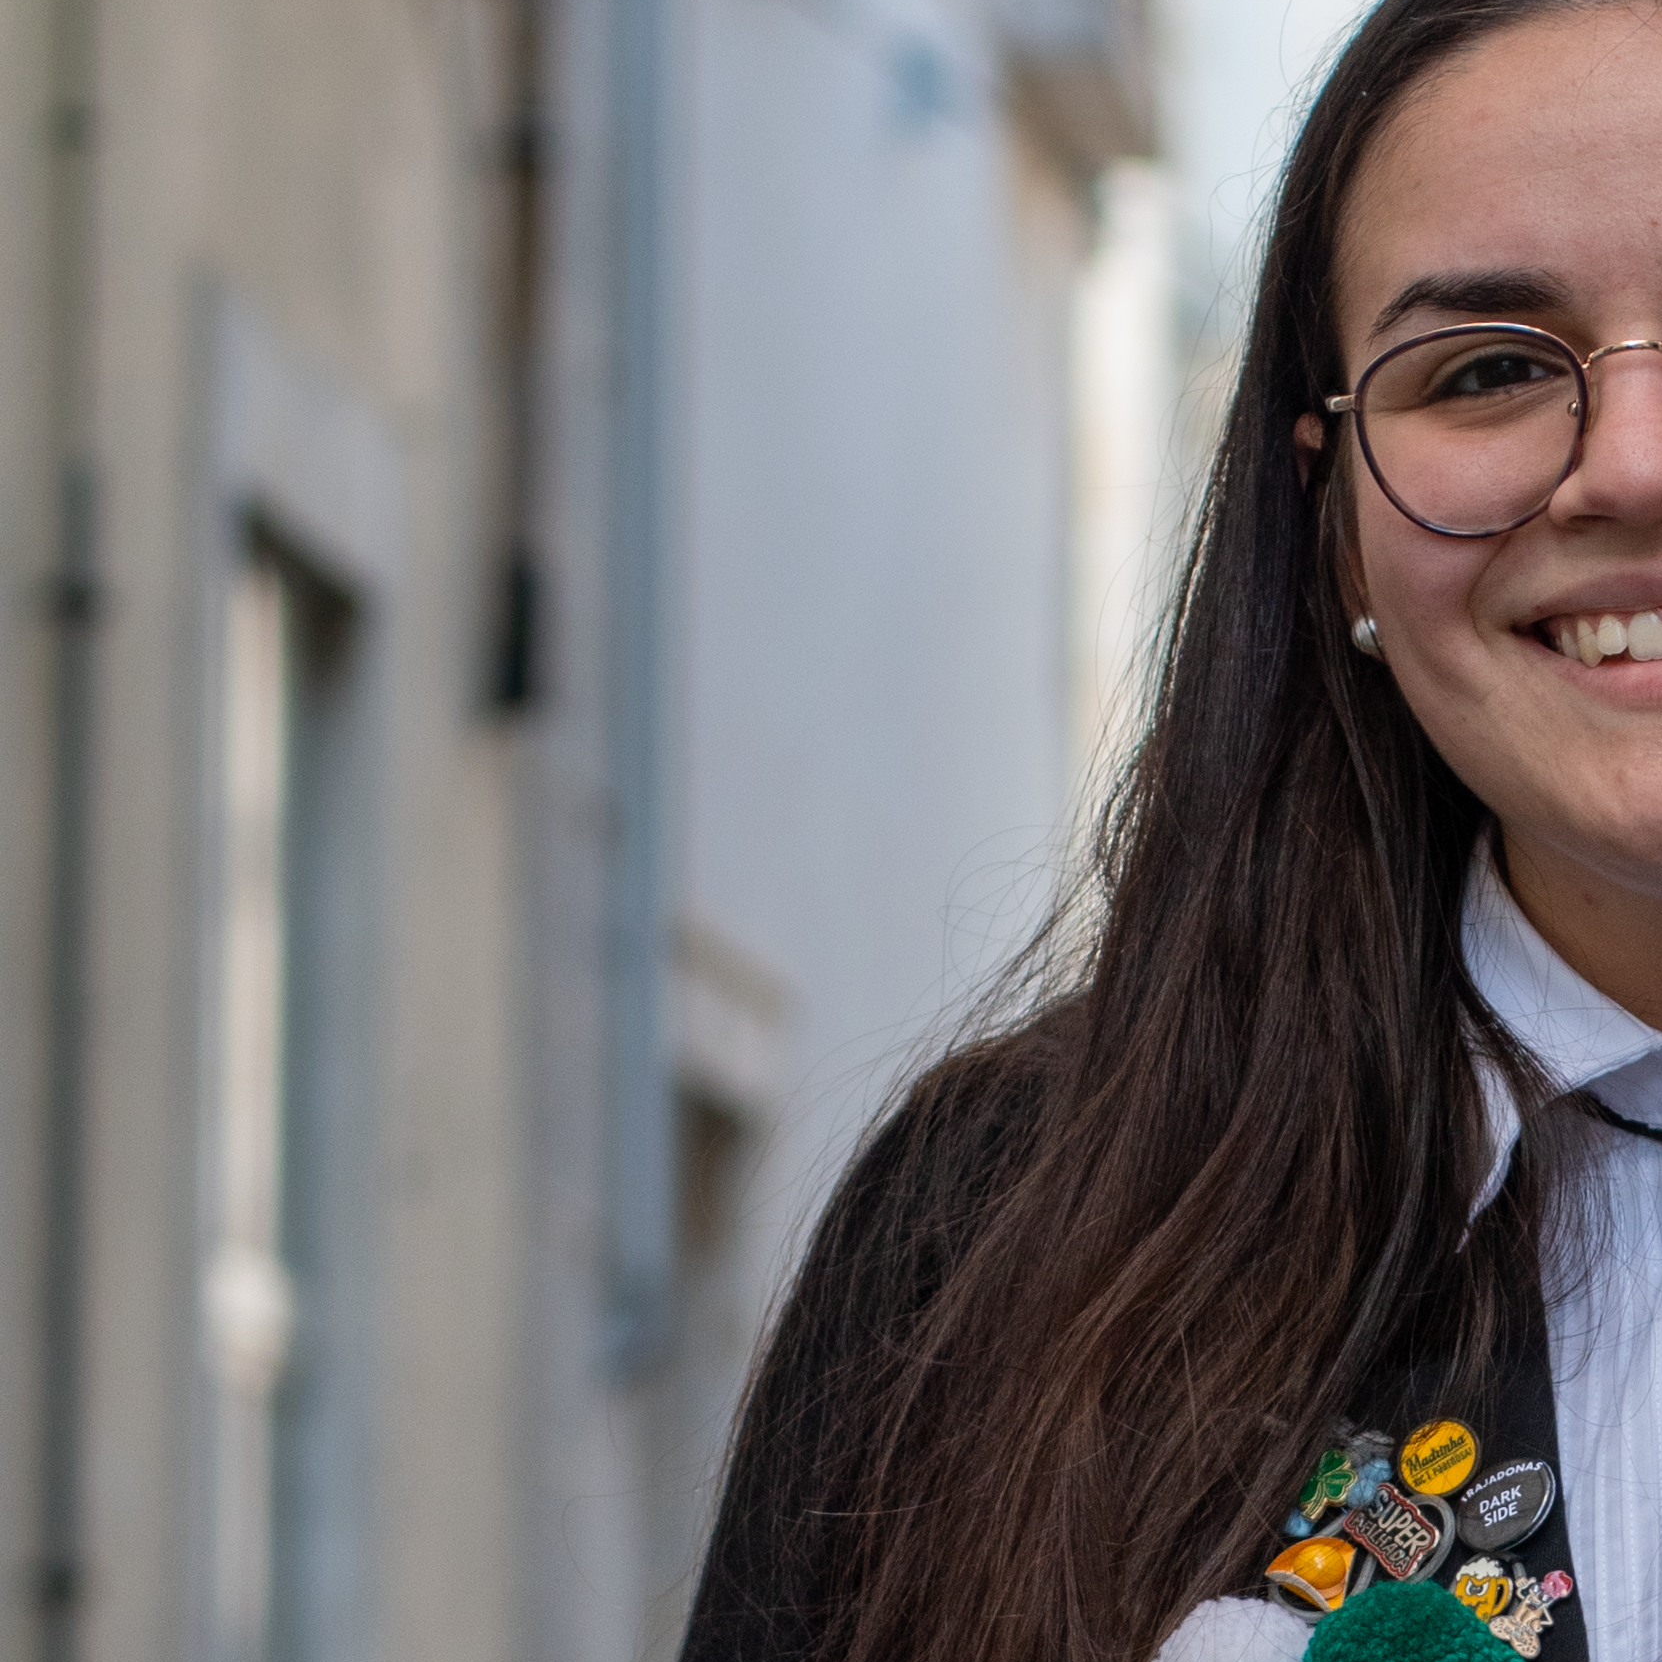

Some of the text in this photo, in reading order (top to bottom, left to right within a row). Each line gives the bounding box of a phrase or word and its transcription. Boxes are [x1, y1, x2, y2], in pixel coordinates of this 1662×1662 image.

[1406, 1435, 1465, 1474] Madrinha
[1461, 1461, 1543, 1502] TRAJADONAS
[1479, 1484, 1522, 1514] DARK
[1368, 1489, 1432, 1557] SUPER
[1484, 1501, 1518, 1527] SIDE
[1348, 1511, 1410, 1571] AFILHADA
